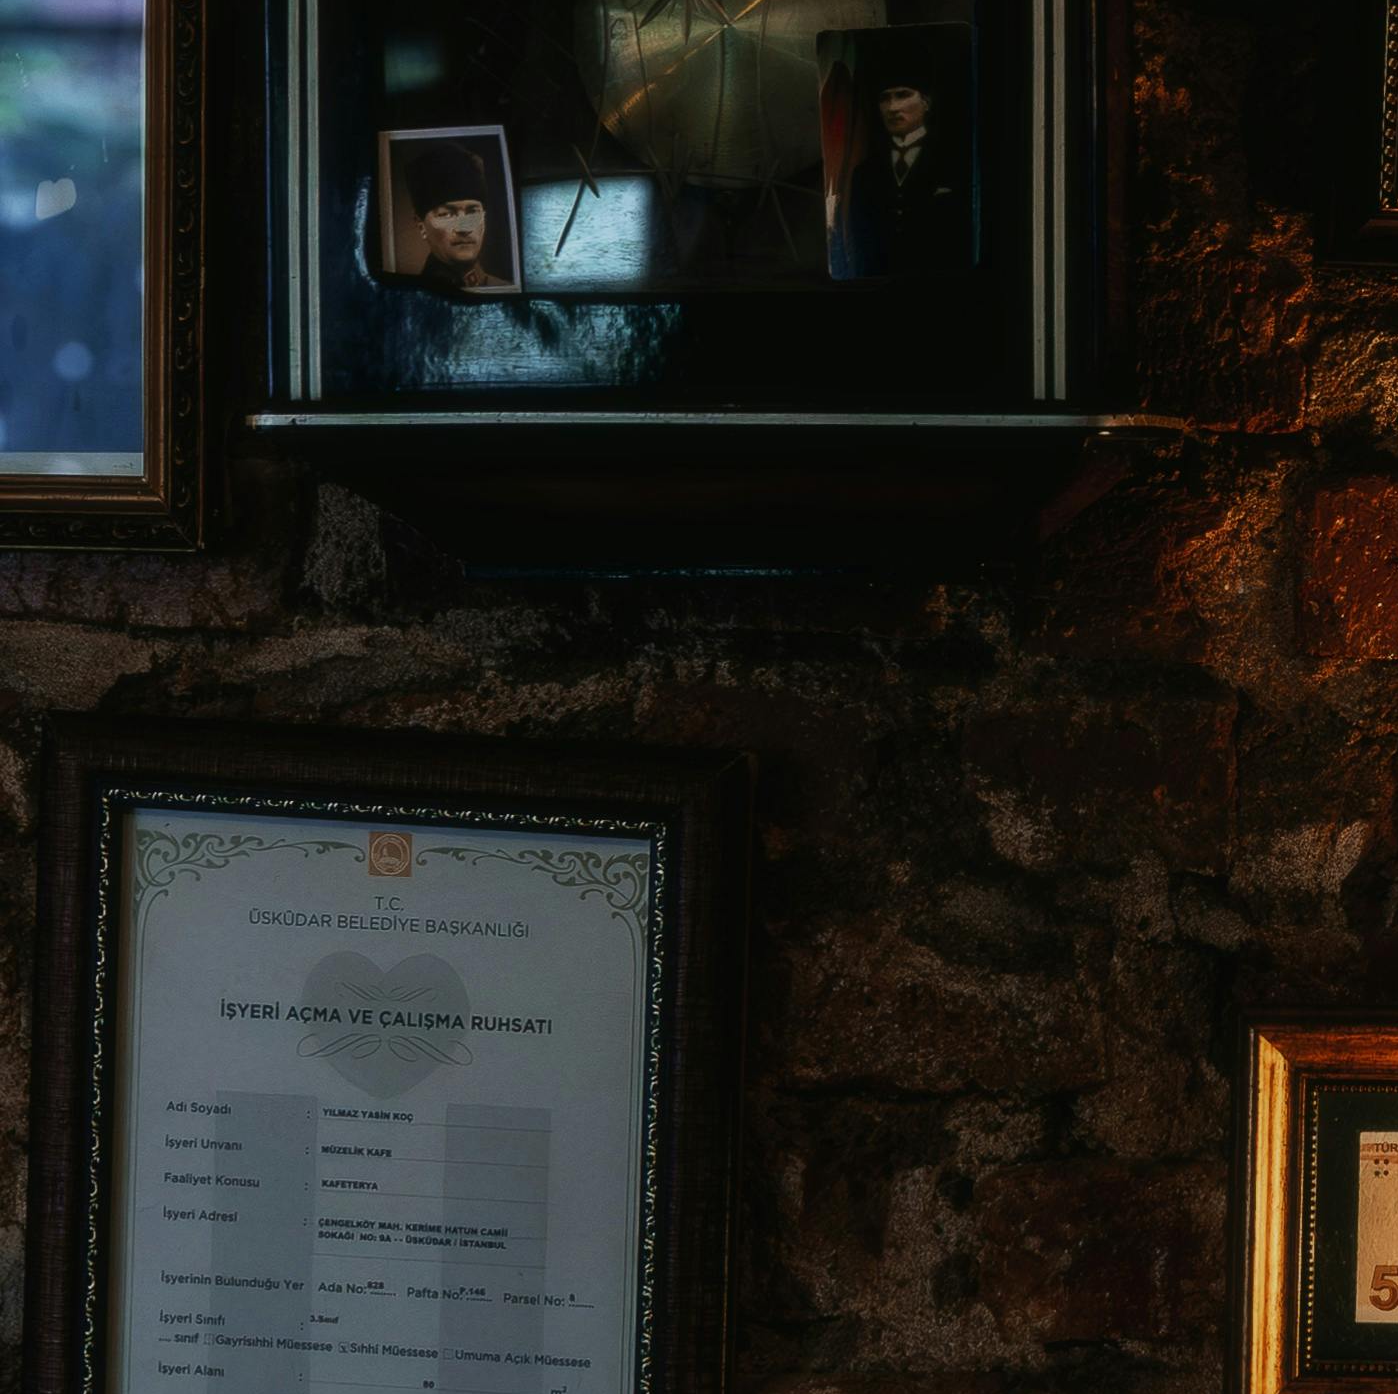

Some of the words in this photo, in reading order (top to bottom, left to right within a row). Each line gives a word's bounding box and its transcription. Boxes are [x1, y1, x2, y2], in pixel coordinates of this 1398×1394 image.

[374, 896, 404, 912] T.C.
[250, 908, 333, 929] ÜSKÜDAR
[337, 913, 420, 933] BELEDİYE
[425, 919, 530, 939] BAŞKANLIĞI
[220, 998, 280, 1021] İŞYERİ
[285, 1005, 342, 1025] AÇMA
[349, 1009, 374, 1024] VE
[379, 1011, 465, 1031] ÇALIŞMA
[470, 1016, 552, 1035] RUHSATI
[166, 1101, 188, 1113] Adı
[190, 1102, 231, 1117] Soyadı
[322, 1108, 359, 1119] YILMAZ
[393, 1112, 414, 1124] KOÇ
[165, 1134, 198, 1151] İşyeri
[200, 1139, 242, 1151] Unvanı
[164, 1172, 212, 1187] Faaliyet
[215, 1175, 260, 1188] Konusu
[321, 1179, 378, 1191] KAFETERYA
[163, 1205, 196, 1221] İşyeri
[200, 1209, 238, 1222] Adresi
[318, 1217, 376, 1230] ÇENGELKÖY
[161, 1270, 212, 1286] İşyerinin
[215, 1274, 280, 1291] Bulunduğu
[283, 1279, 305, 1291] Yer
[318, 1282, 343, 1294] Ada
[407, 1286, 439, 1300] Pafta
[503, 1292, 541, 1306] Parsel
[159, 1309, 192, 1325] İşyeri
[195, 1313, 226, 1326] Sınıfı
[215, 1334, 274, 1350] Gayrisıhhi
[276, 1338, 333, 1353] Müessese
[350, 1342, 379, 1355] Sıhhi
[382, 1344, 438, 1359] Müessese
[455, 1349, 500, 1363] Umuma
[504, 1352, 532, 1366] Açık
[534, 1353, 592, 1369] Müessese
[158, 1360, 191, 1376] İşyeri
[194, 1364, 225, 1377] Alanı
